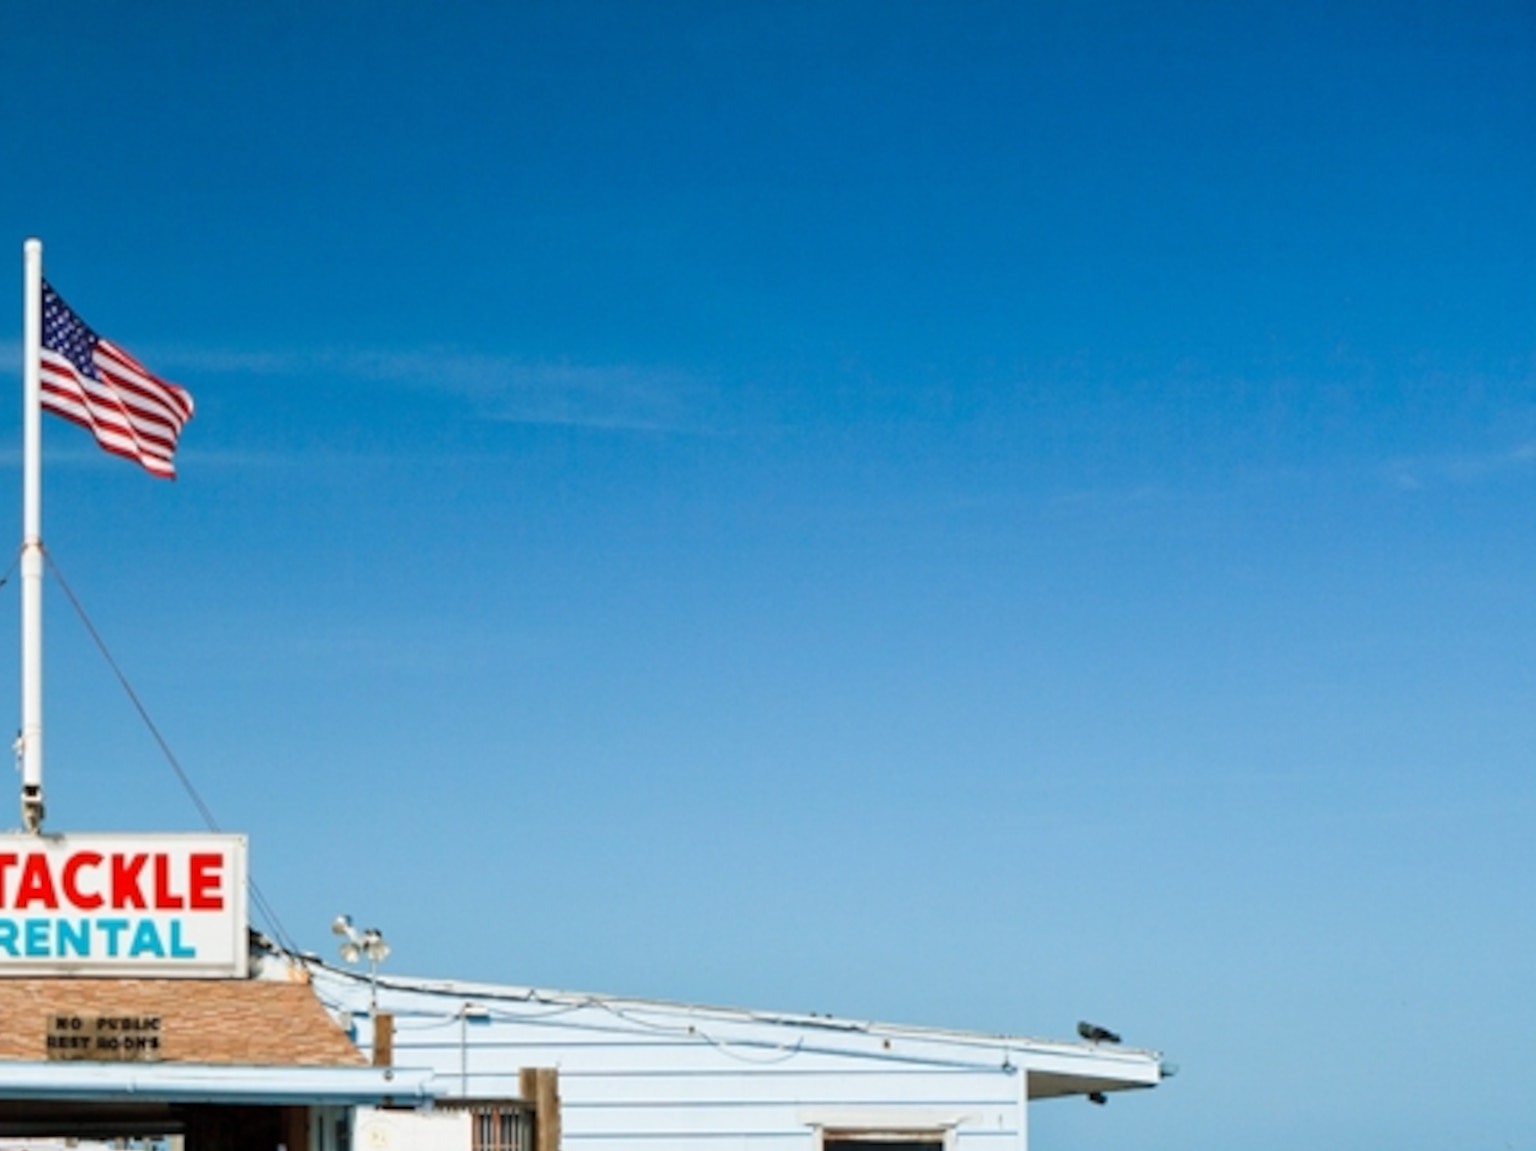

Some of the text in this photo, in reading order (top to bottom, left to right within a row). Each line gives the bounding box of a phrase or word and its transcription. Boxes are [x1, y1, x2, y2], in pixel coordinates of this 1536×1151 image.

[56, 1017, 161, 1030] NO PUBLIC
[47, 1036, 90, 1049] REST
